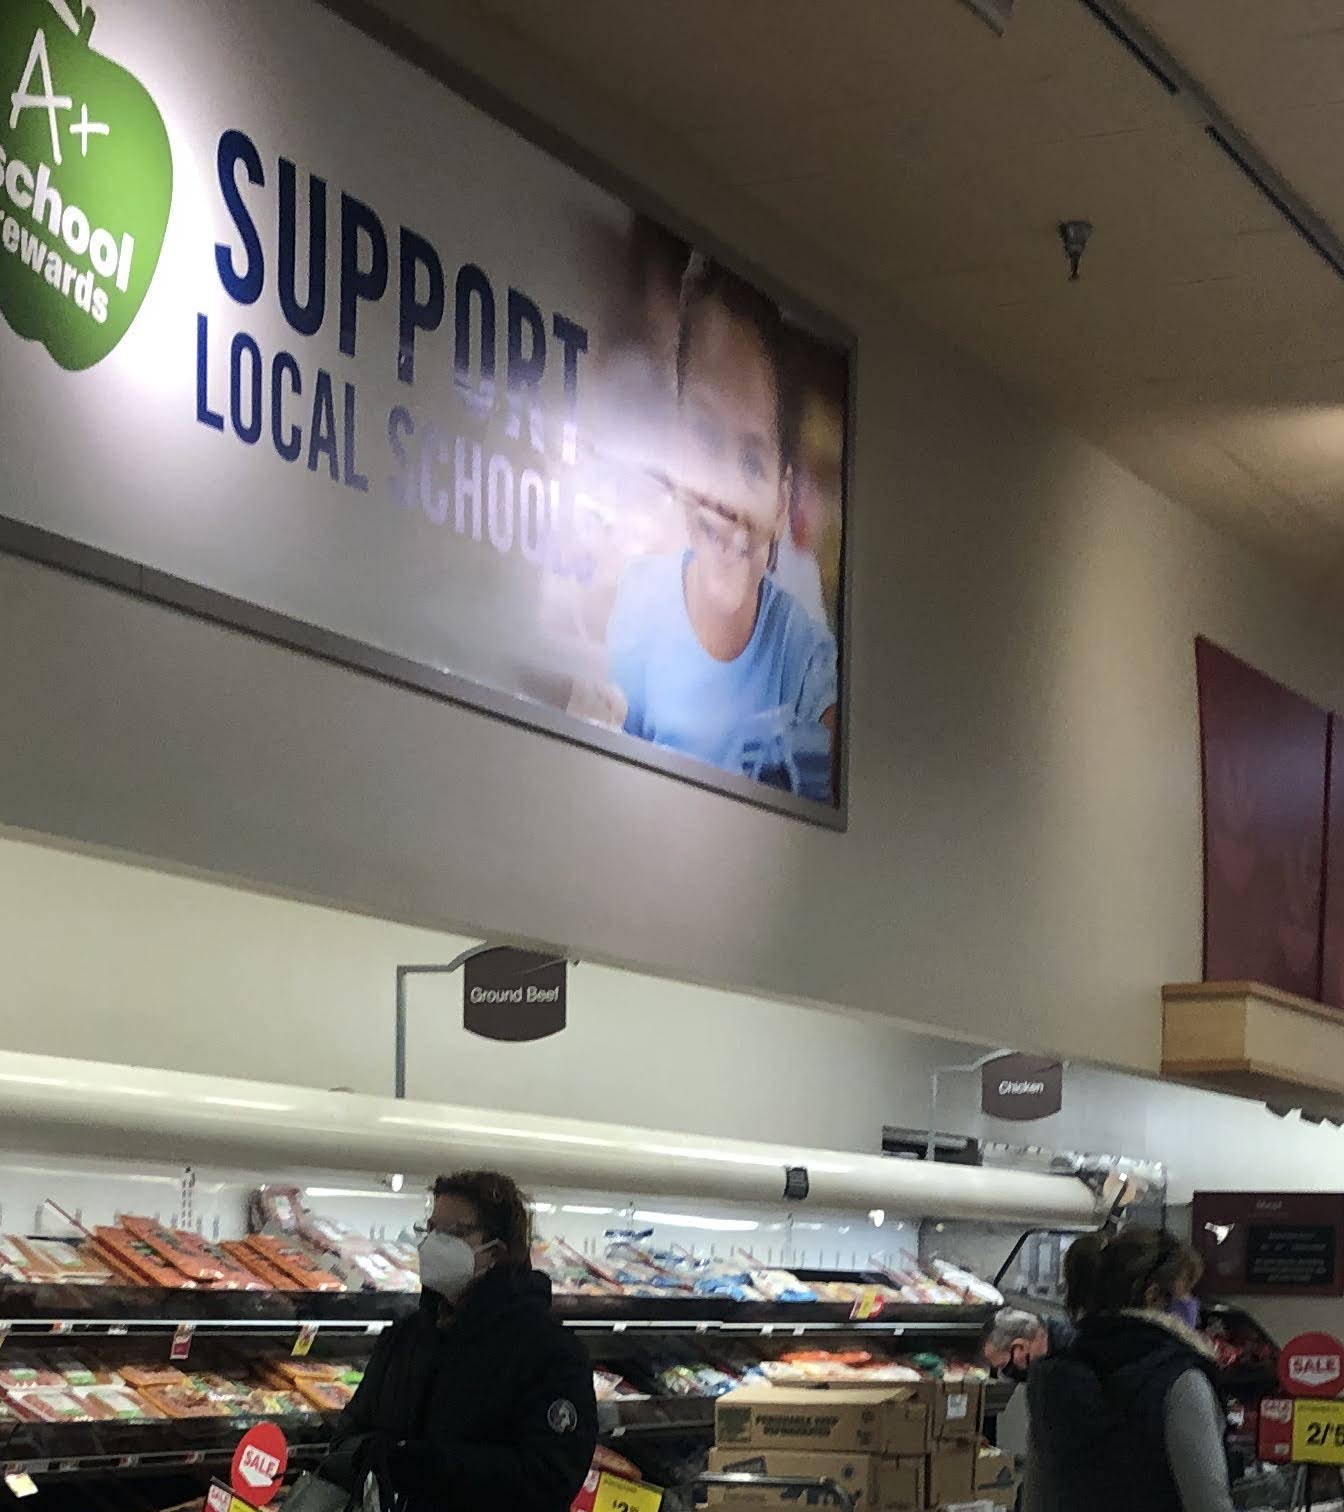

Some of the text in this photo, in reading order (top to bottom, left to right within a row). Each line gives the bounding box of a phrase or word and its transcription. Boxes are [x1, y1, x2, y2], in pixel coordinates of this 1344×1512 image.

[213, 128, 589, 465] SUPPORT
[195, 312, 369, 493] LOCAL
[470, 985, 560, 1003] Ground Beef
[1292, 1358, 1337, 1374] SALE
[243, 1450, 276, 1477] SALE
